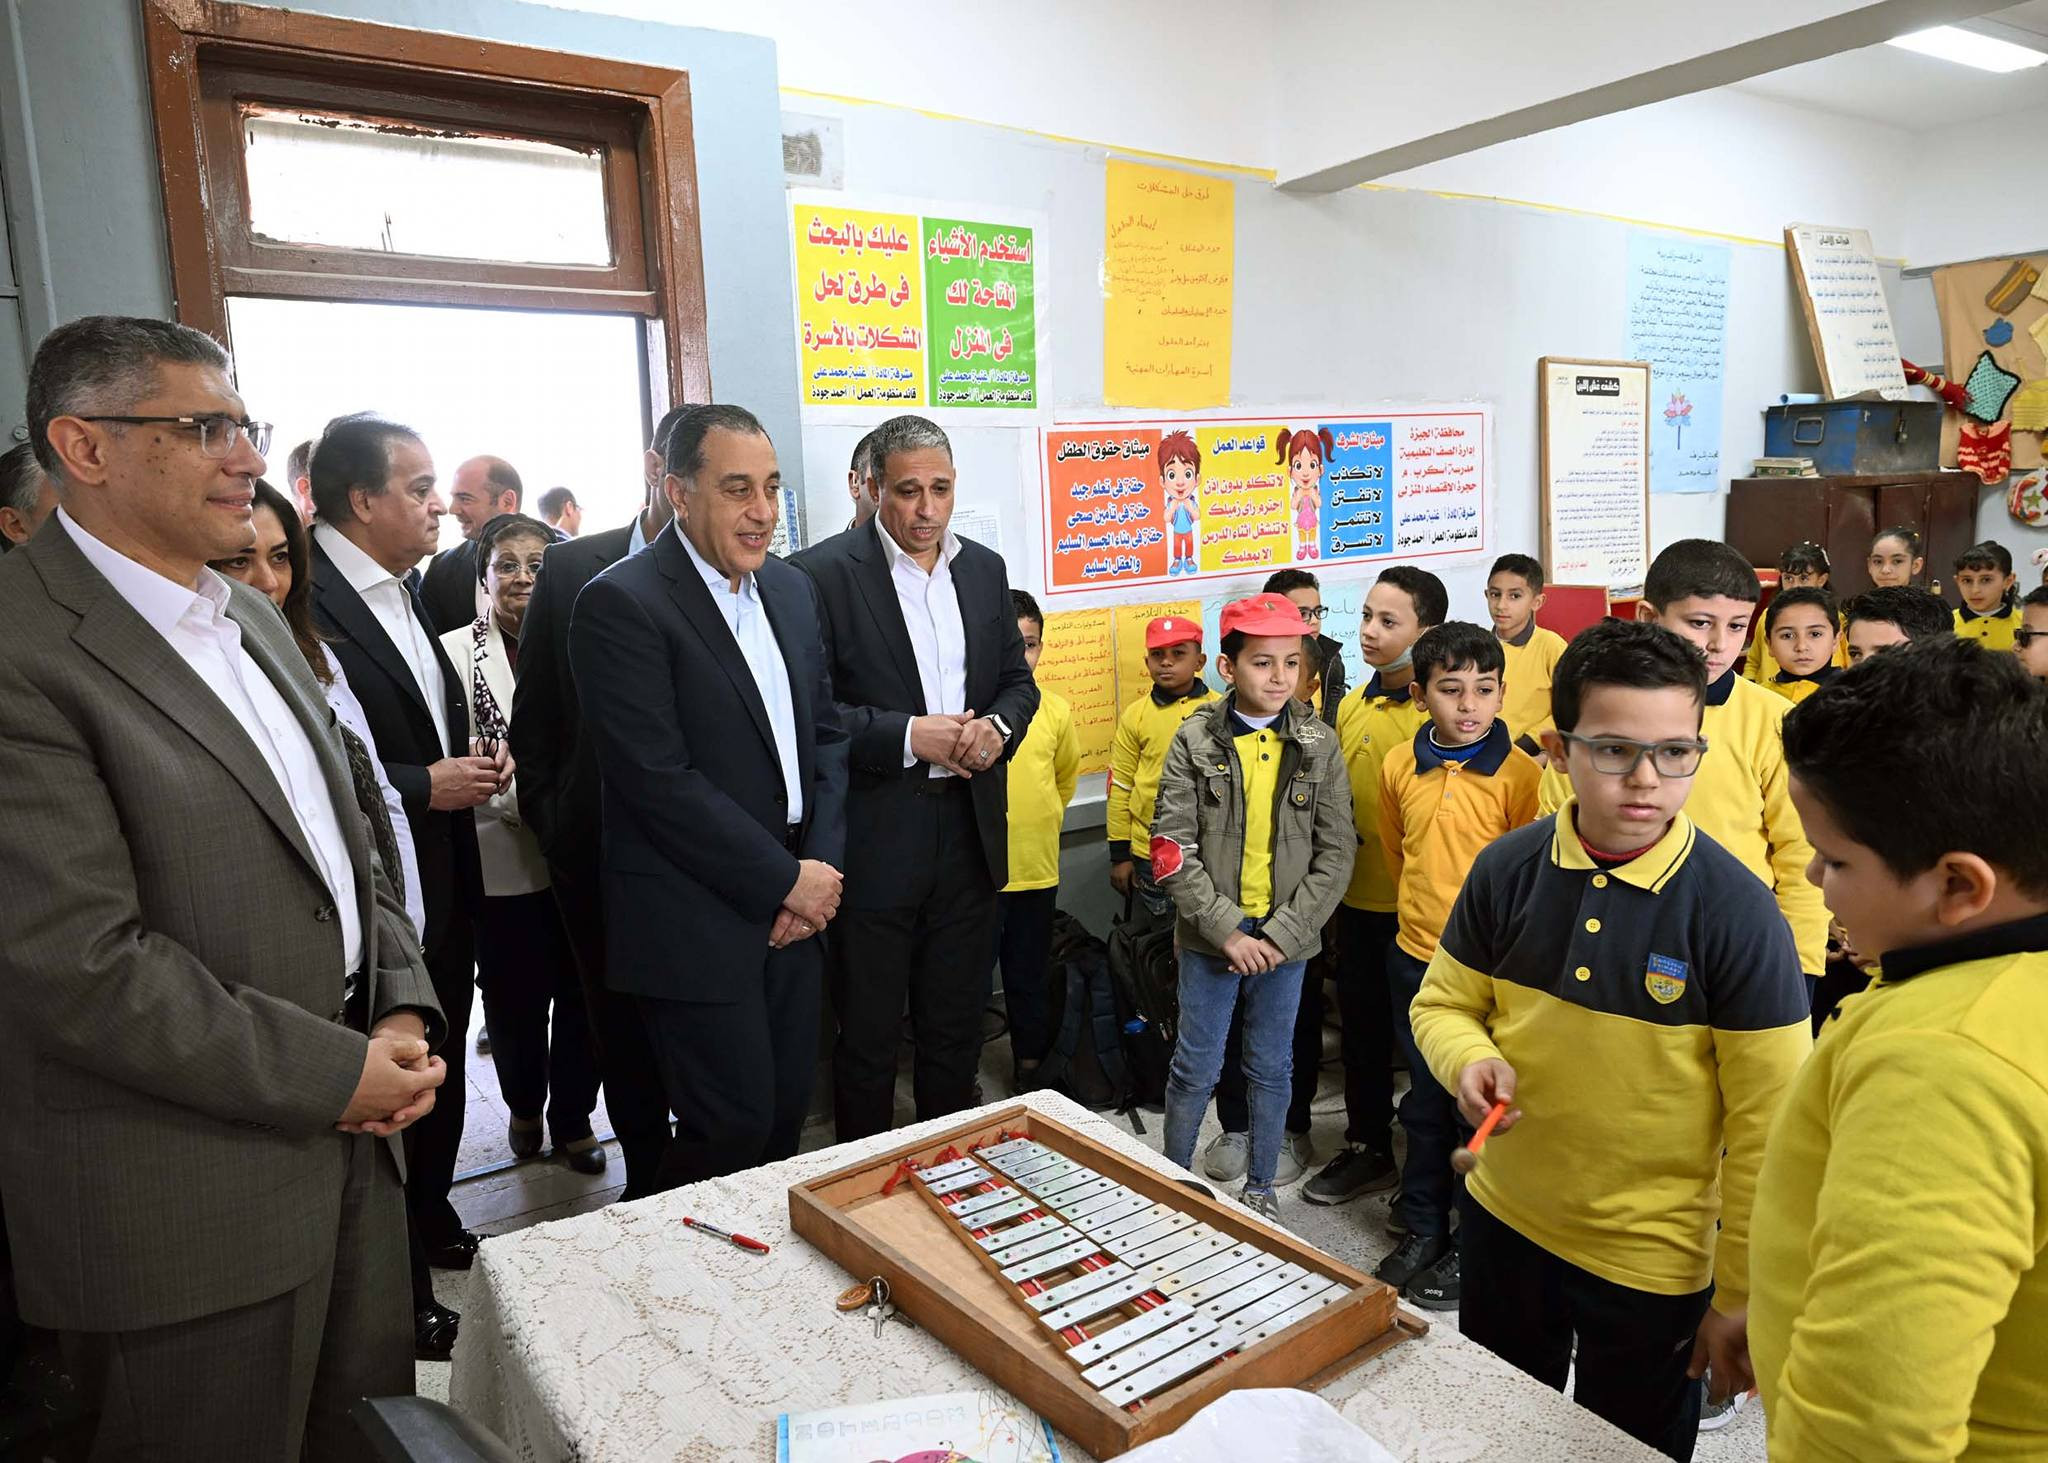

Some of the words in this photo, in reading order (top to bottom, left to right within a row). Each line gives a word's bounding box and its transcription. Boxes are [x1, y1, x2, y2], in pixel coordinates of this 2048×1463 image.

[808, 217, 863, 256] بالبحث
[867, 224, 909, 257] عليك
[928, 227, 977, 262] الأشياء
[979, 235, 1031, 267] استخدم
[815, 270, 844, 302] لحل
[848, 271, 887, 305] طرق
[890, 274, 910, 308] فى
[947, 280, 969, 305] لك
[973, 279, 1016, 311] المتاحة
[804, 320, 855, 353] بالأسرة
[857, 325, 921, 350] المشكلات
[950, 327, 991, 359] المنزل
[993, 328, 1013, 360] فى
[829, 367, 848, 377] محمد
[890, 367, 913, 381] مشرفة
[954, 371, 972, 381] محمد
[1011, 371, 1029, 385] مشرفة
[812, 385, 830, 400] جودة
[857, 387, 877, 400] العمل
[876, 387, 903, 401] منظومة
[903, 387, 917, 399] قائد
[979, 390, 996, 402] العمل
[996, 390, 1020, 403] منظومة
[1020, 390, 1032, 401] قائد
[1336, 432, 1363, 450] الشرف
[1363, 431, 1384, 449] ميثاق
[1409, 426, 1434, 441] الجيزة
[1435, 427, 1465, 440] محافظة
[1057, 442, 1091, 462] الطفل
[1091, 441, 1121, 460] حقوق
[1122, 439, 1150, 459] ميثاق
[1212, 438, 1238, 455] العمل
[1240, 435, 1266, 454] قواعد
[1399, 446, 1435, 460] التعليمية
[1330, 465, 1373, 485] تكذب
[1373, 466, 1383, 479] لا
[1448, 463, 1474, 476] مدرسة
[1091, 479, 1111, 497] تعلم
[1112, 479, 1124, 498] فى
[1220, 479, 1243, 494] بدون
[1276, 475, 1284, 487] لا
[1457, 480, 1477, 494] حجرة
[1071, 482, 1089, 499] جيد
[1372, 488, 1382, 501] لا
[1095, 503, 1117, 524] تأمين
[1118, 504, 1130, 523] فى
[1208, 500, 1241, 518] زميلك
[1372, 511, 1382, 524] لا
[1411, 512, 1426, 522] محمد
[1067, 511, 1093, 527] صحى
[1281, 522, 1289, 534] لا
[1056, 534, 1085, 553] السليم
[1087, 533, 1114, 550] الجسم
[1115, 531, 1130, 549] بناء
[1131, 529, 1143, 548] فى
[1202, 527, 1232, 545] الدرس
[1374, 533, 1383, 546] لا
[1112, 556, 1141, 575] والعقل
[1222, 550, 1261, 564] بمعلمك
[1082, 558, 1112, 577] السليم
